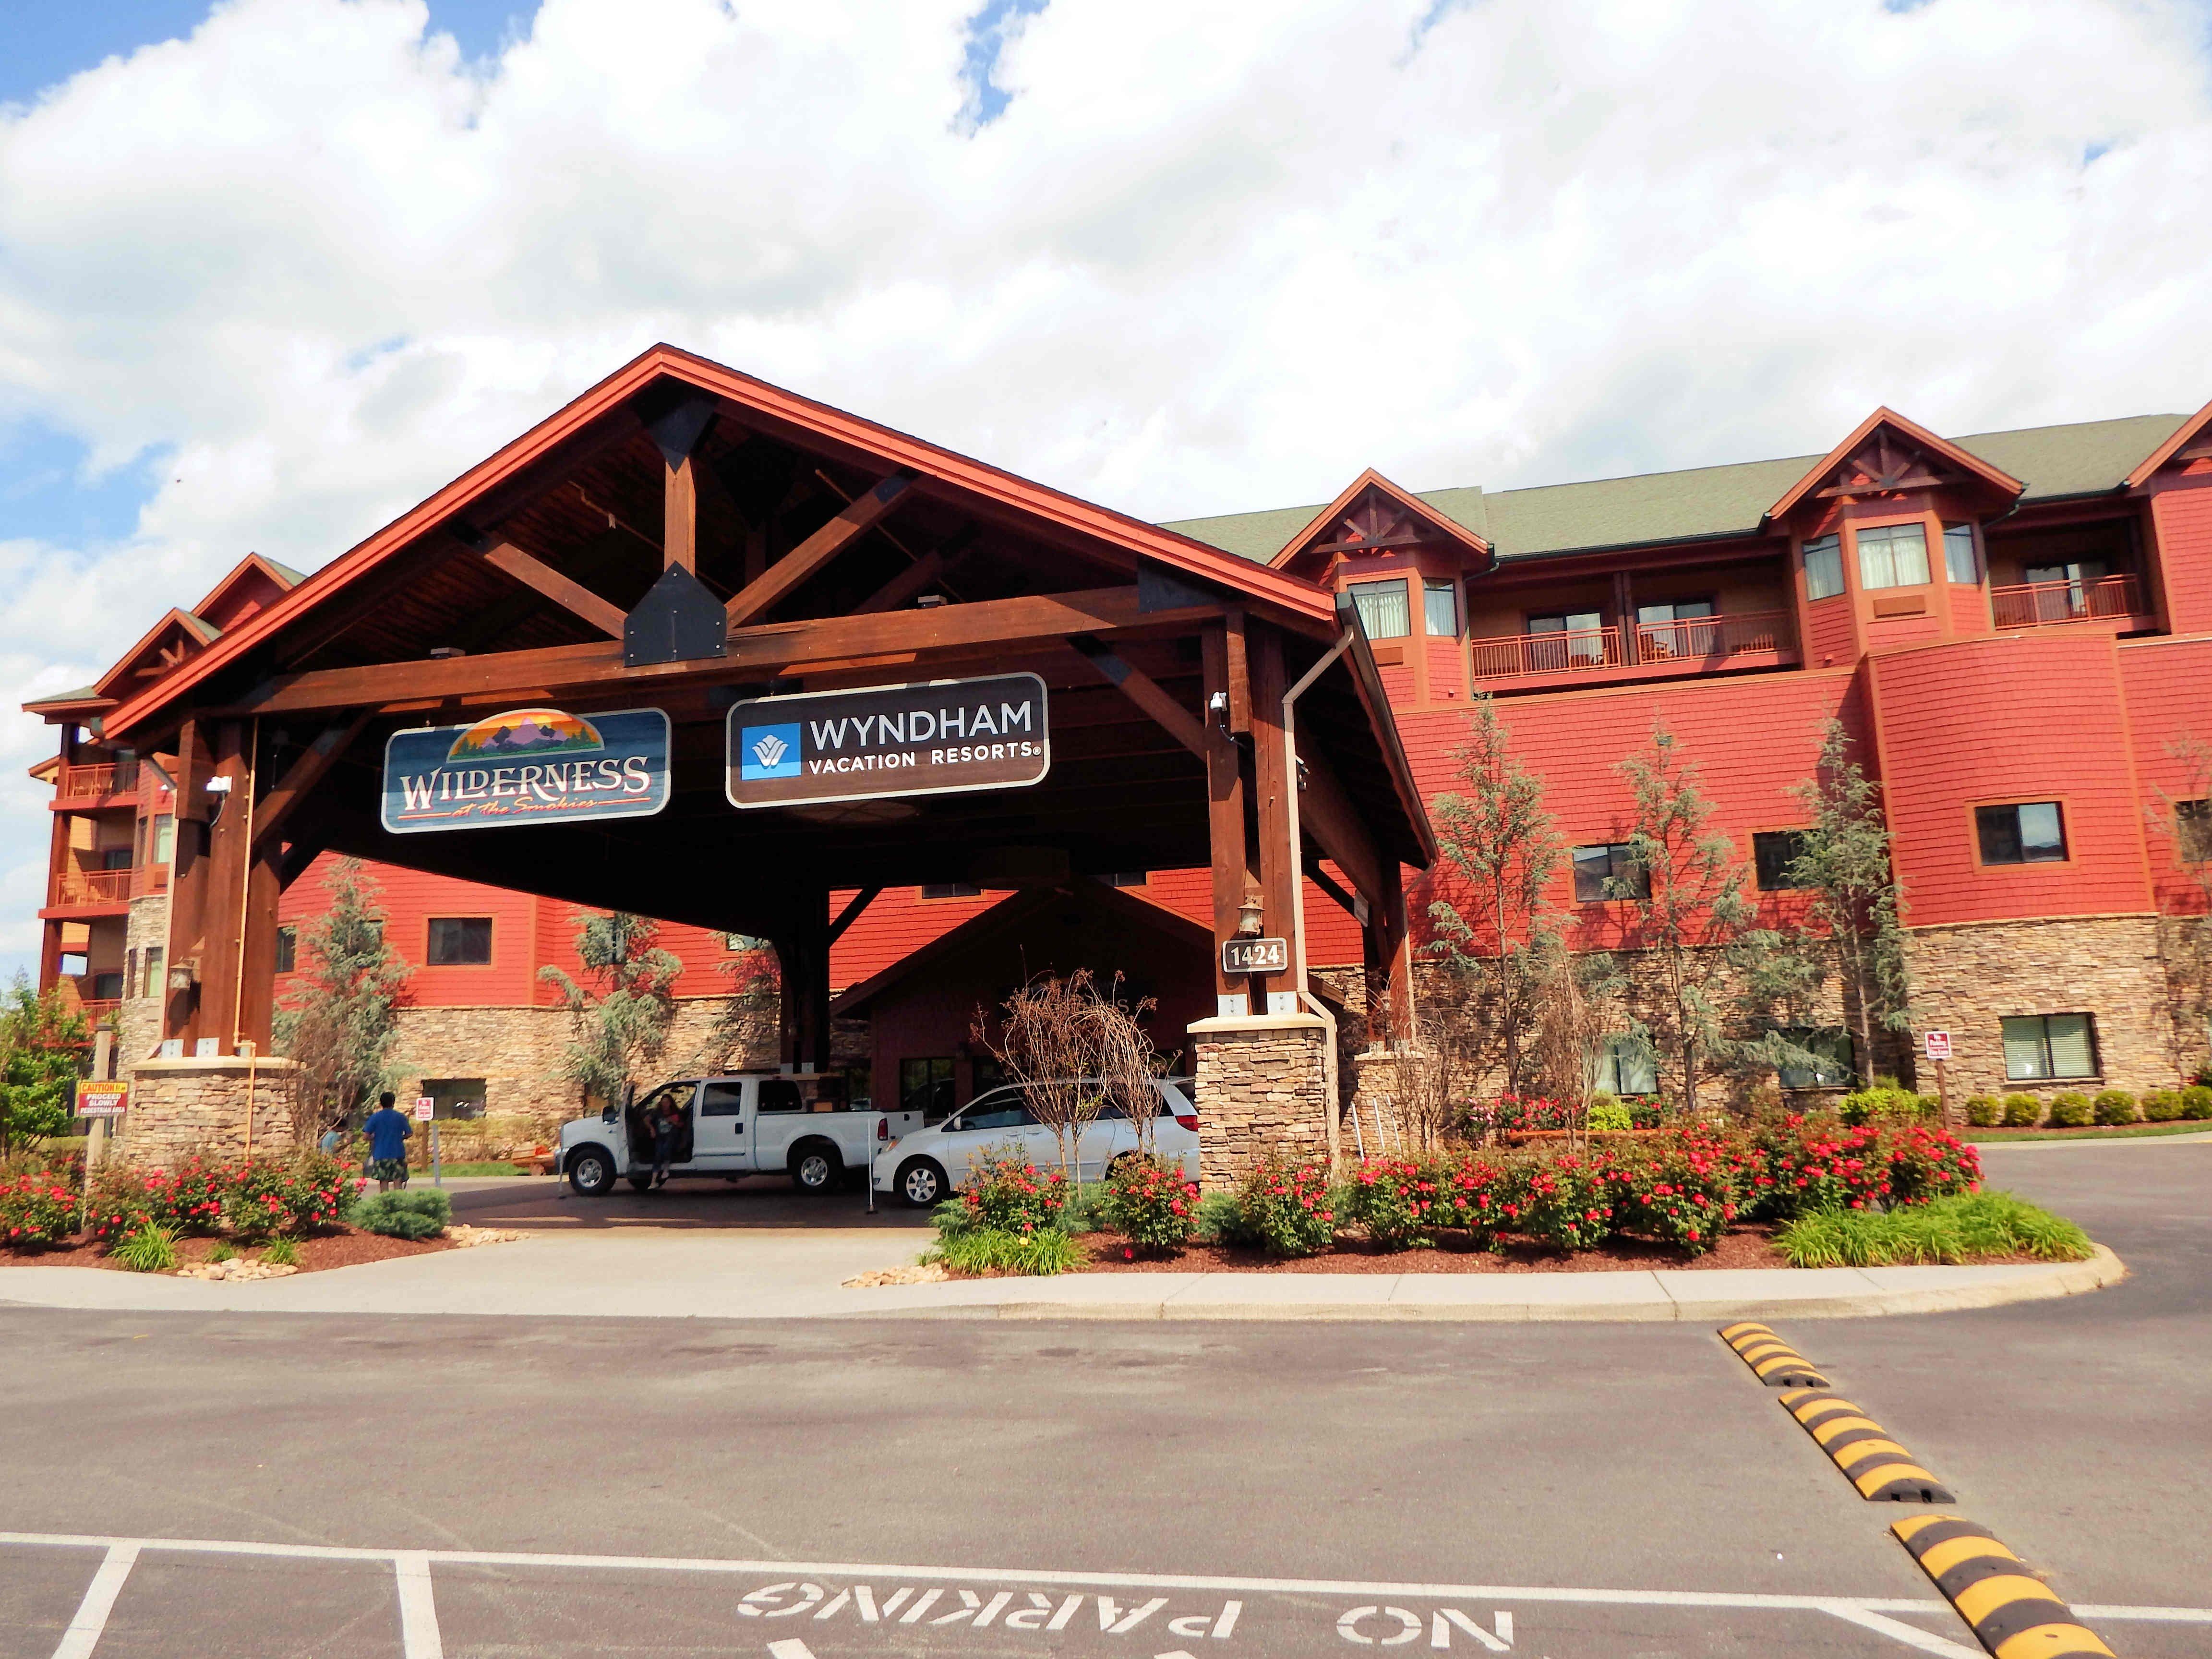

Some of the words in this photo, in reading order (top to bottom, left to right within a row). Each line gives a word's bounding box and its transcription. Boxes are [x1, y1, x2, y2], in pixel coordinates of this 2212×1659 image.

[810, 701, 1031, 750] WYNDHAM
[400, 756, 651, 811] WILDERNESS
[808, 751, 915, 775] VACATION
[452, 802, 476, 817] at
[478, 800, 510, 815] the
[513, 796, 597, 814] Smokies
[1231, 944, 1279, 966] 1424
[737, 1583, 1242, 1638] PARKING
[1336, 1606, 1514, 1650] NO
